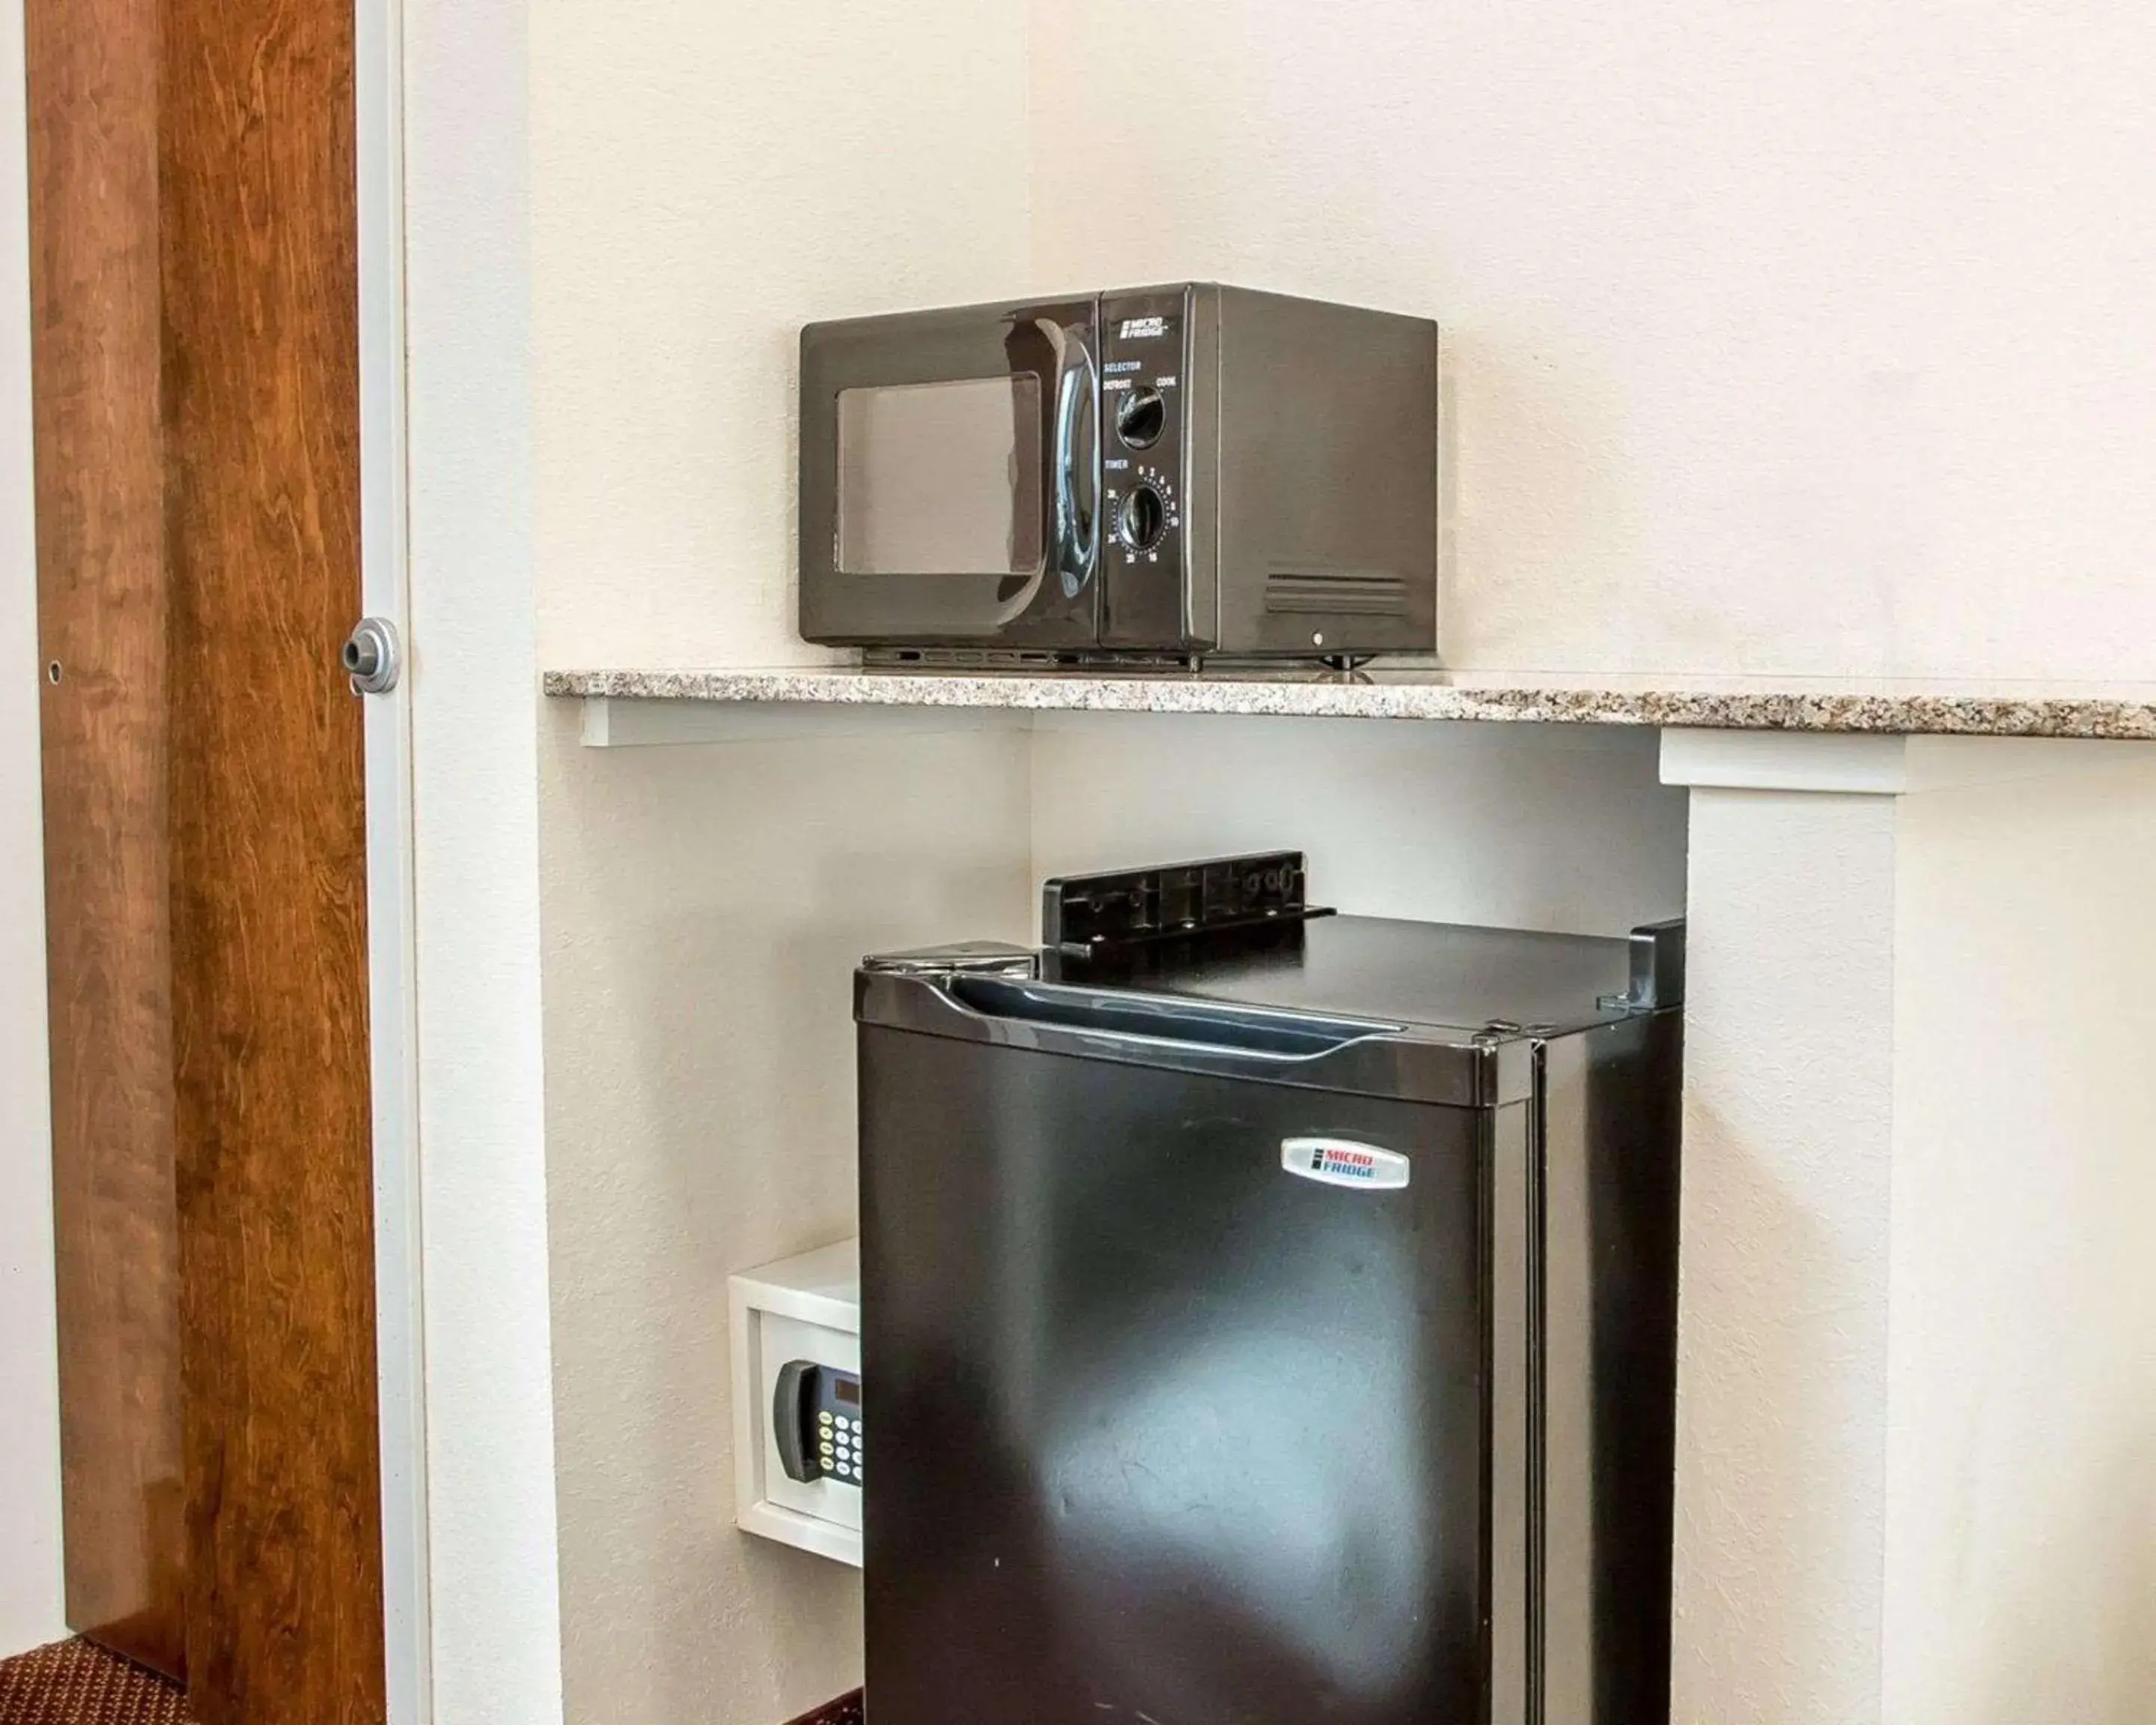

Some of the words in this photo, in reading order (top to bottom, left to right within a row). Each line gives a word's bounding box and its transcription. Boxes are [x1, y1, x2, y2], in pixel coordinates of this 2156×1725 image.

[1104, 361, 1141, 373] SELECTOR
[1156, 377, 1176, 386] COOK
[1105, 460, 1128, 469] TIMER
[1325, 1149, 1374, 1166] MICRO
[1324, 1161, 1376, 1178] FRIDGE
